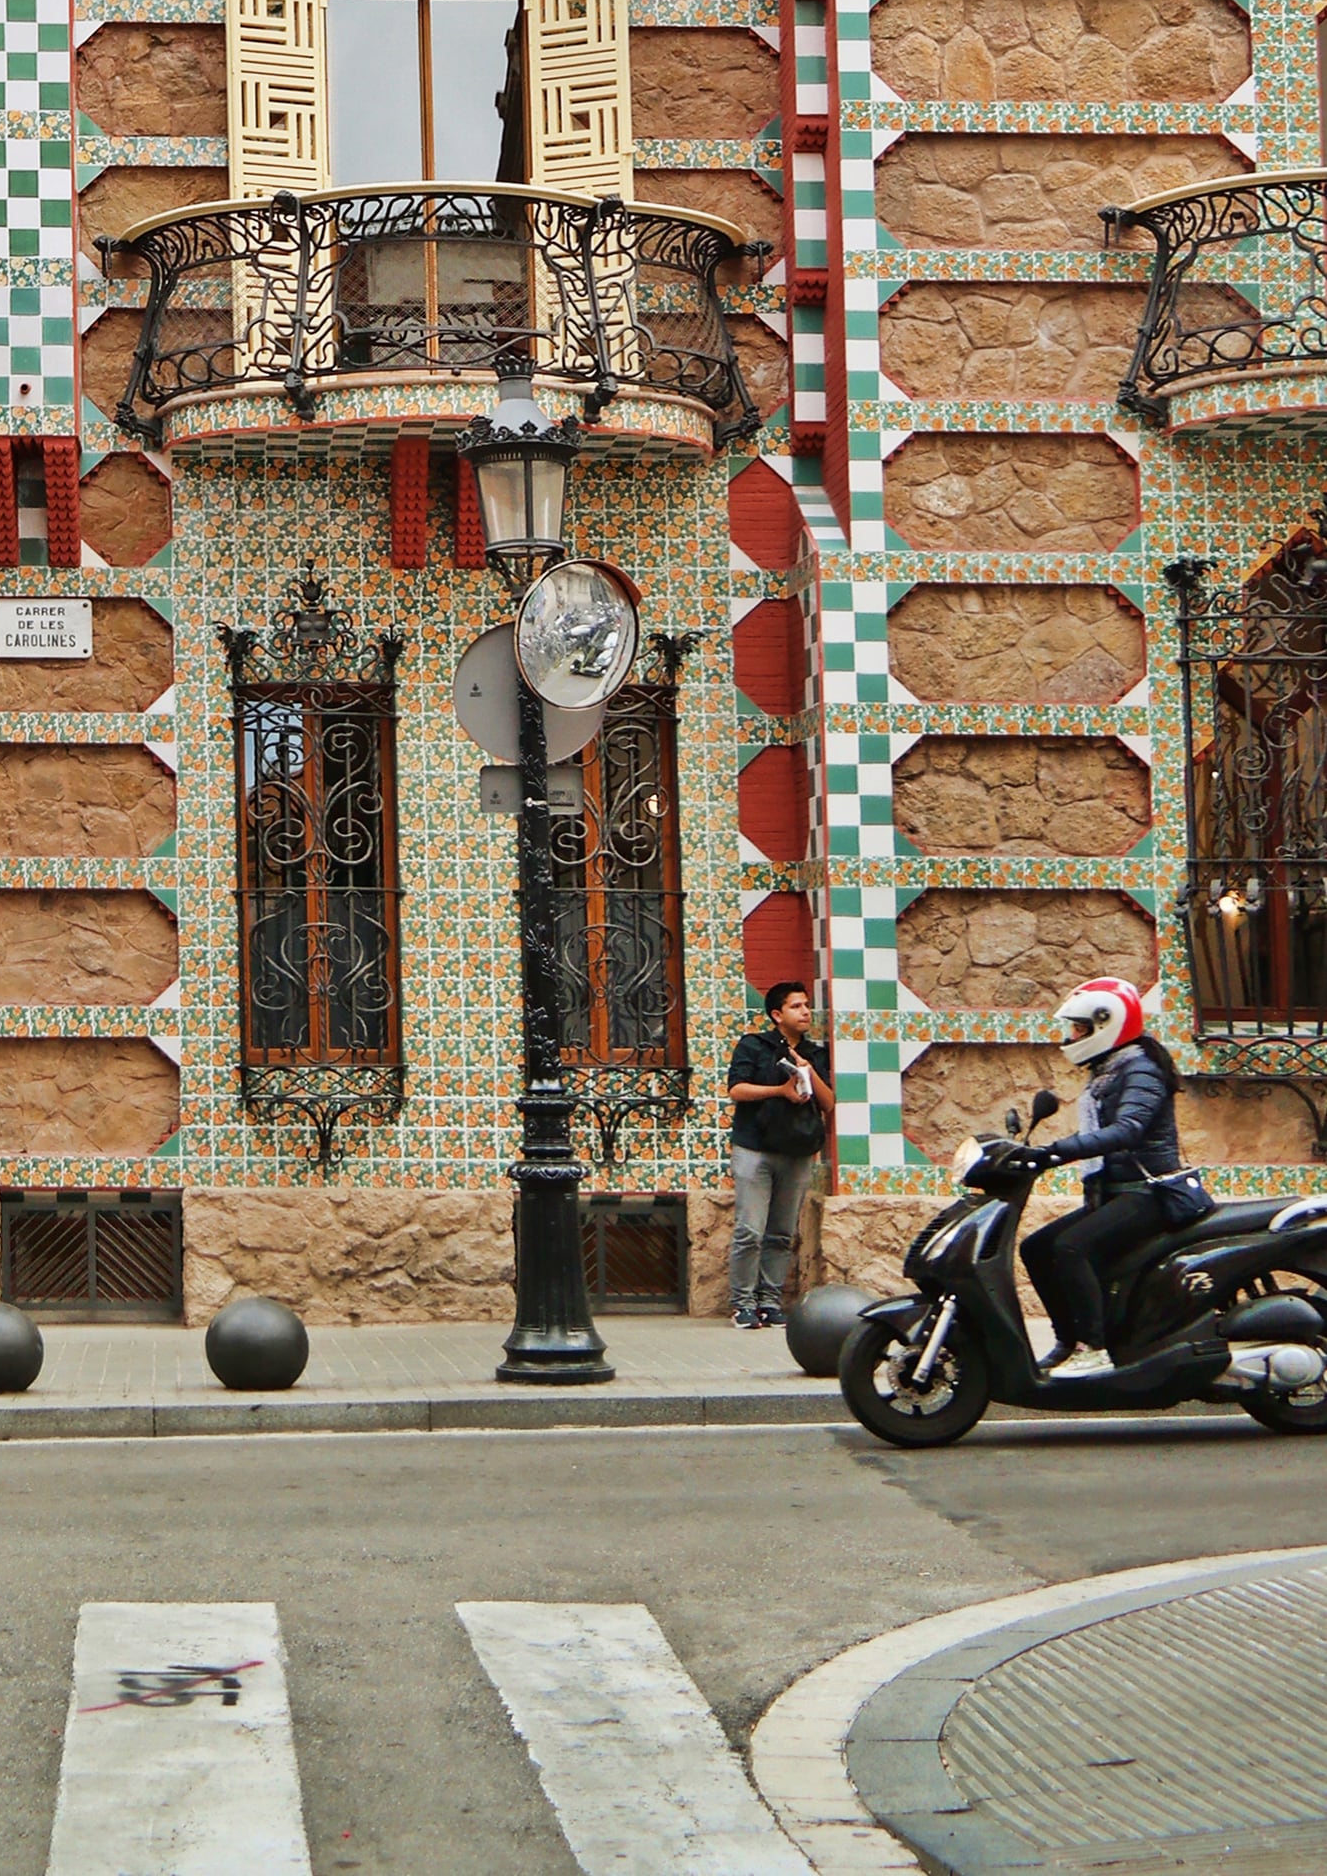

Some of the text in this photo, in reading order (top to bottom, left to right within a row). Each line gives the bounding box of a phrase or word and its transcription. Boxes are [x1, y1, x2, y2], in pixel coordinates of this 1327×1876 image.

[16, 607, 66, 616] CARRER
[18, 620, 64, 629] DE LES
[5, 633, 76, 647] CAROLINES
